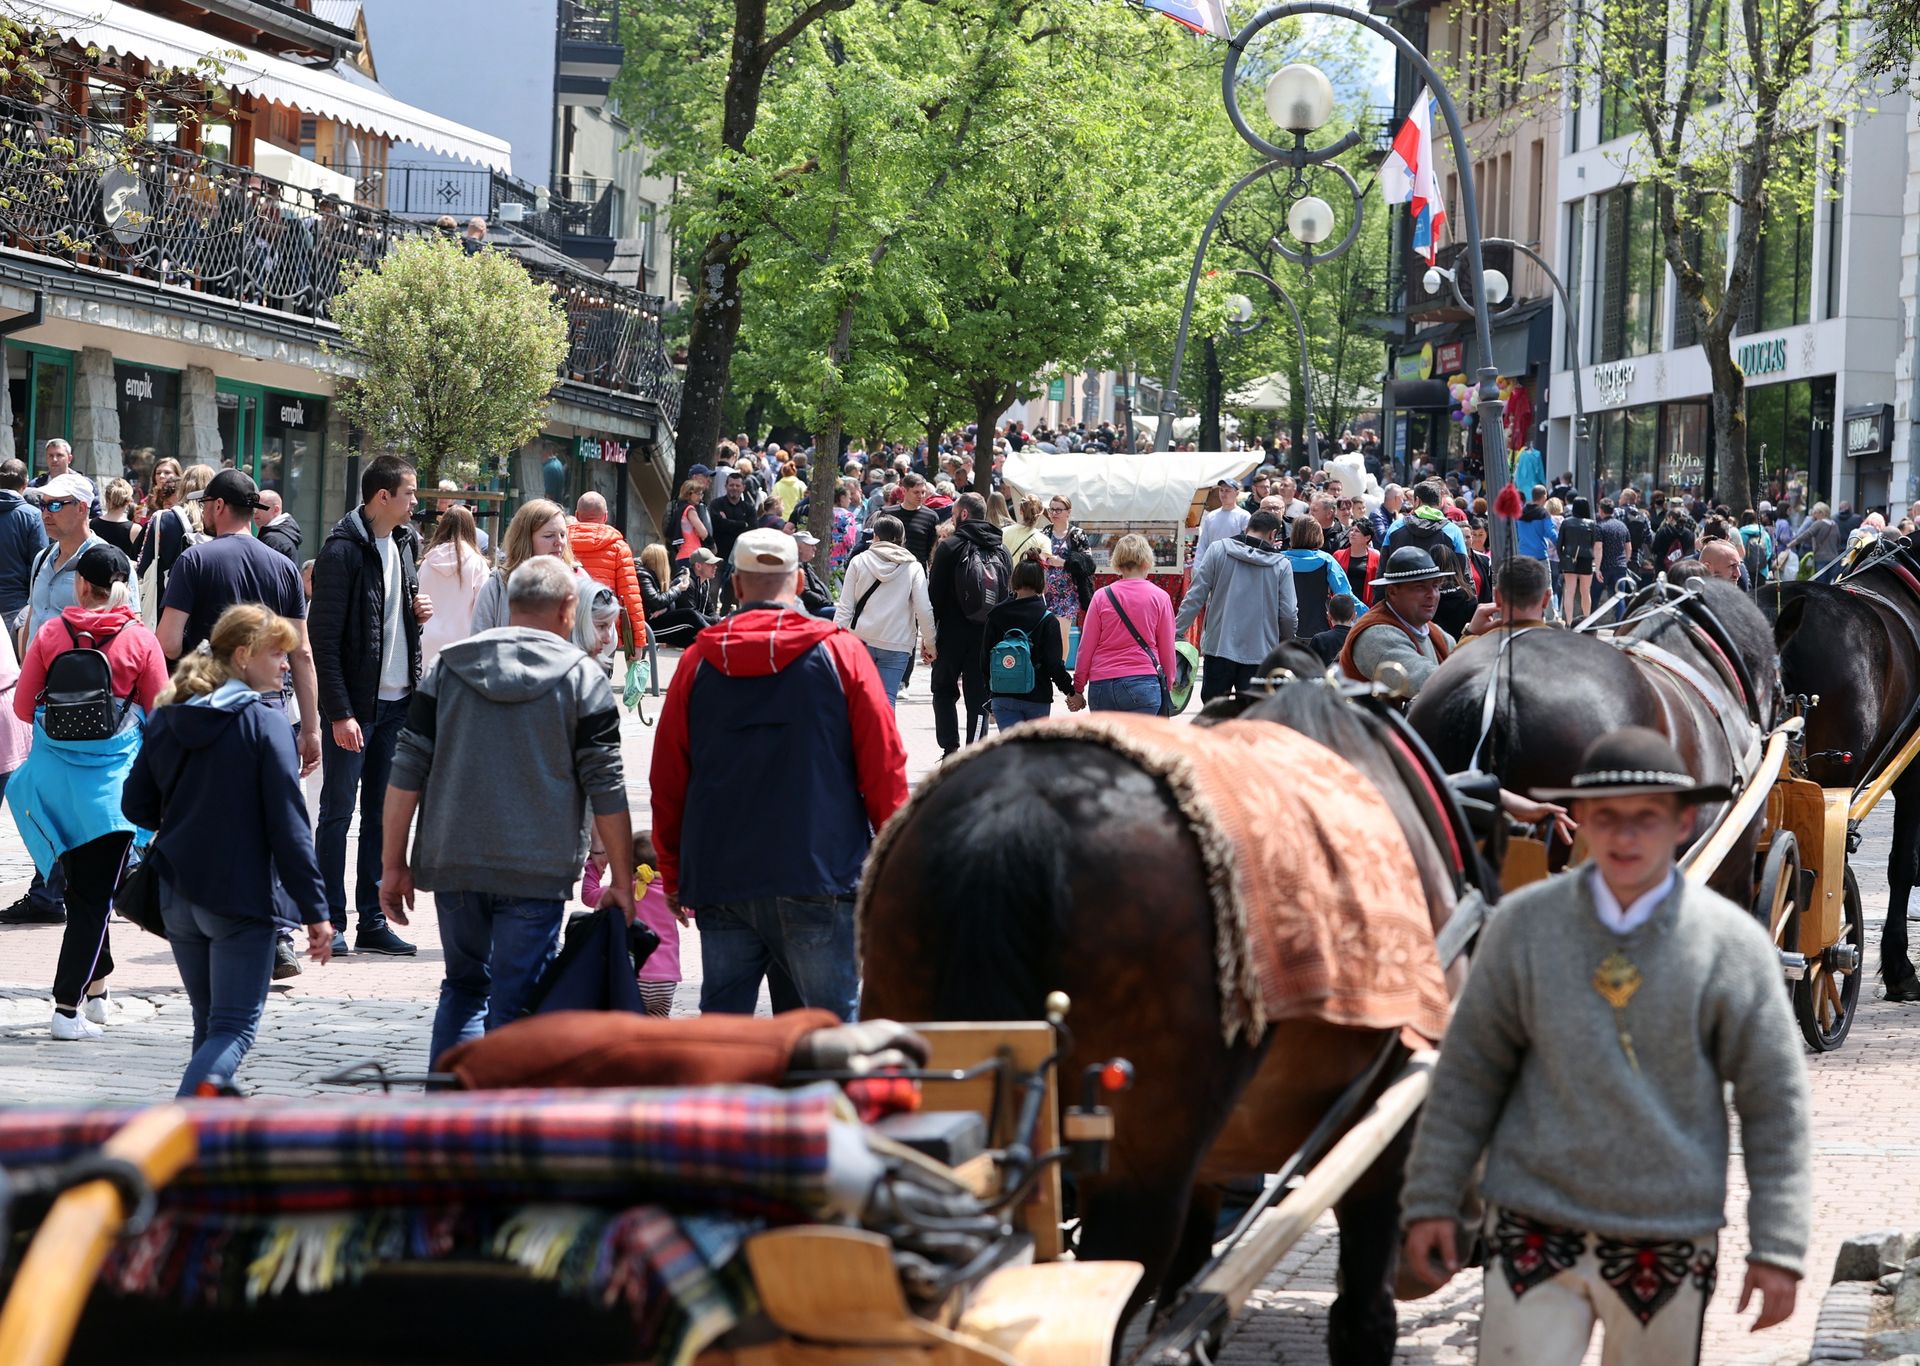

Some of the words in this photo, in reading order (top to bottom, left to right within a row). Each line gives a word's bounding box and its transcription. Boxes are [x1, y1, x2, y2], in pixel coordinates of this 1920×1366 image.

[1738, 337, 1787, 377] DOUGLAS
[125, 372, 153, 401] empik
[280, 400, 304, 427] empik
[579, 437, 602, 462] Apteka
